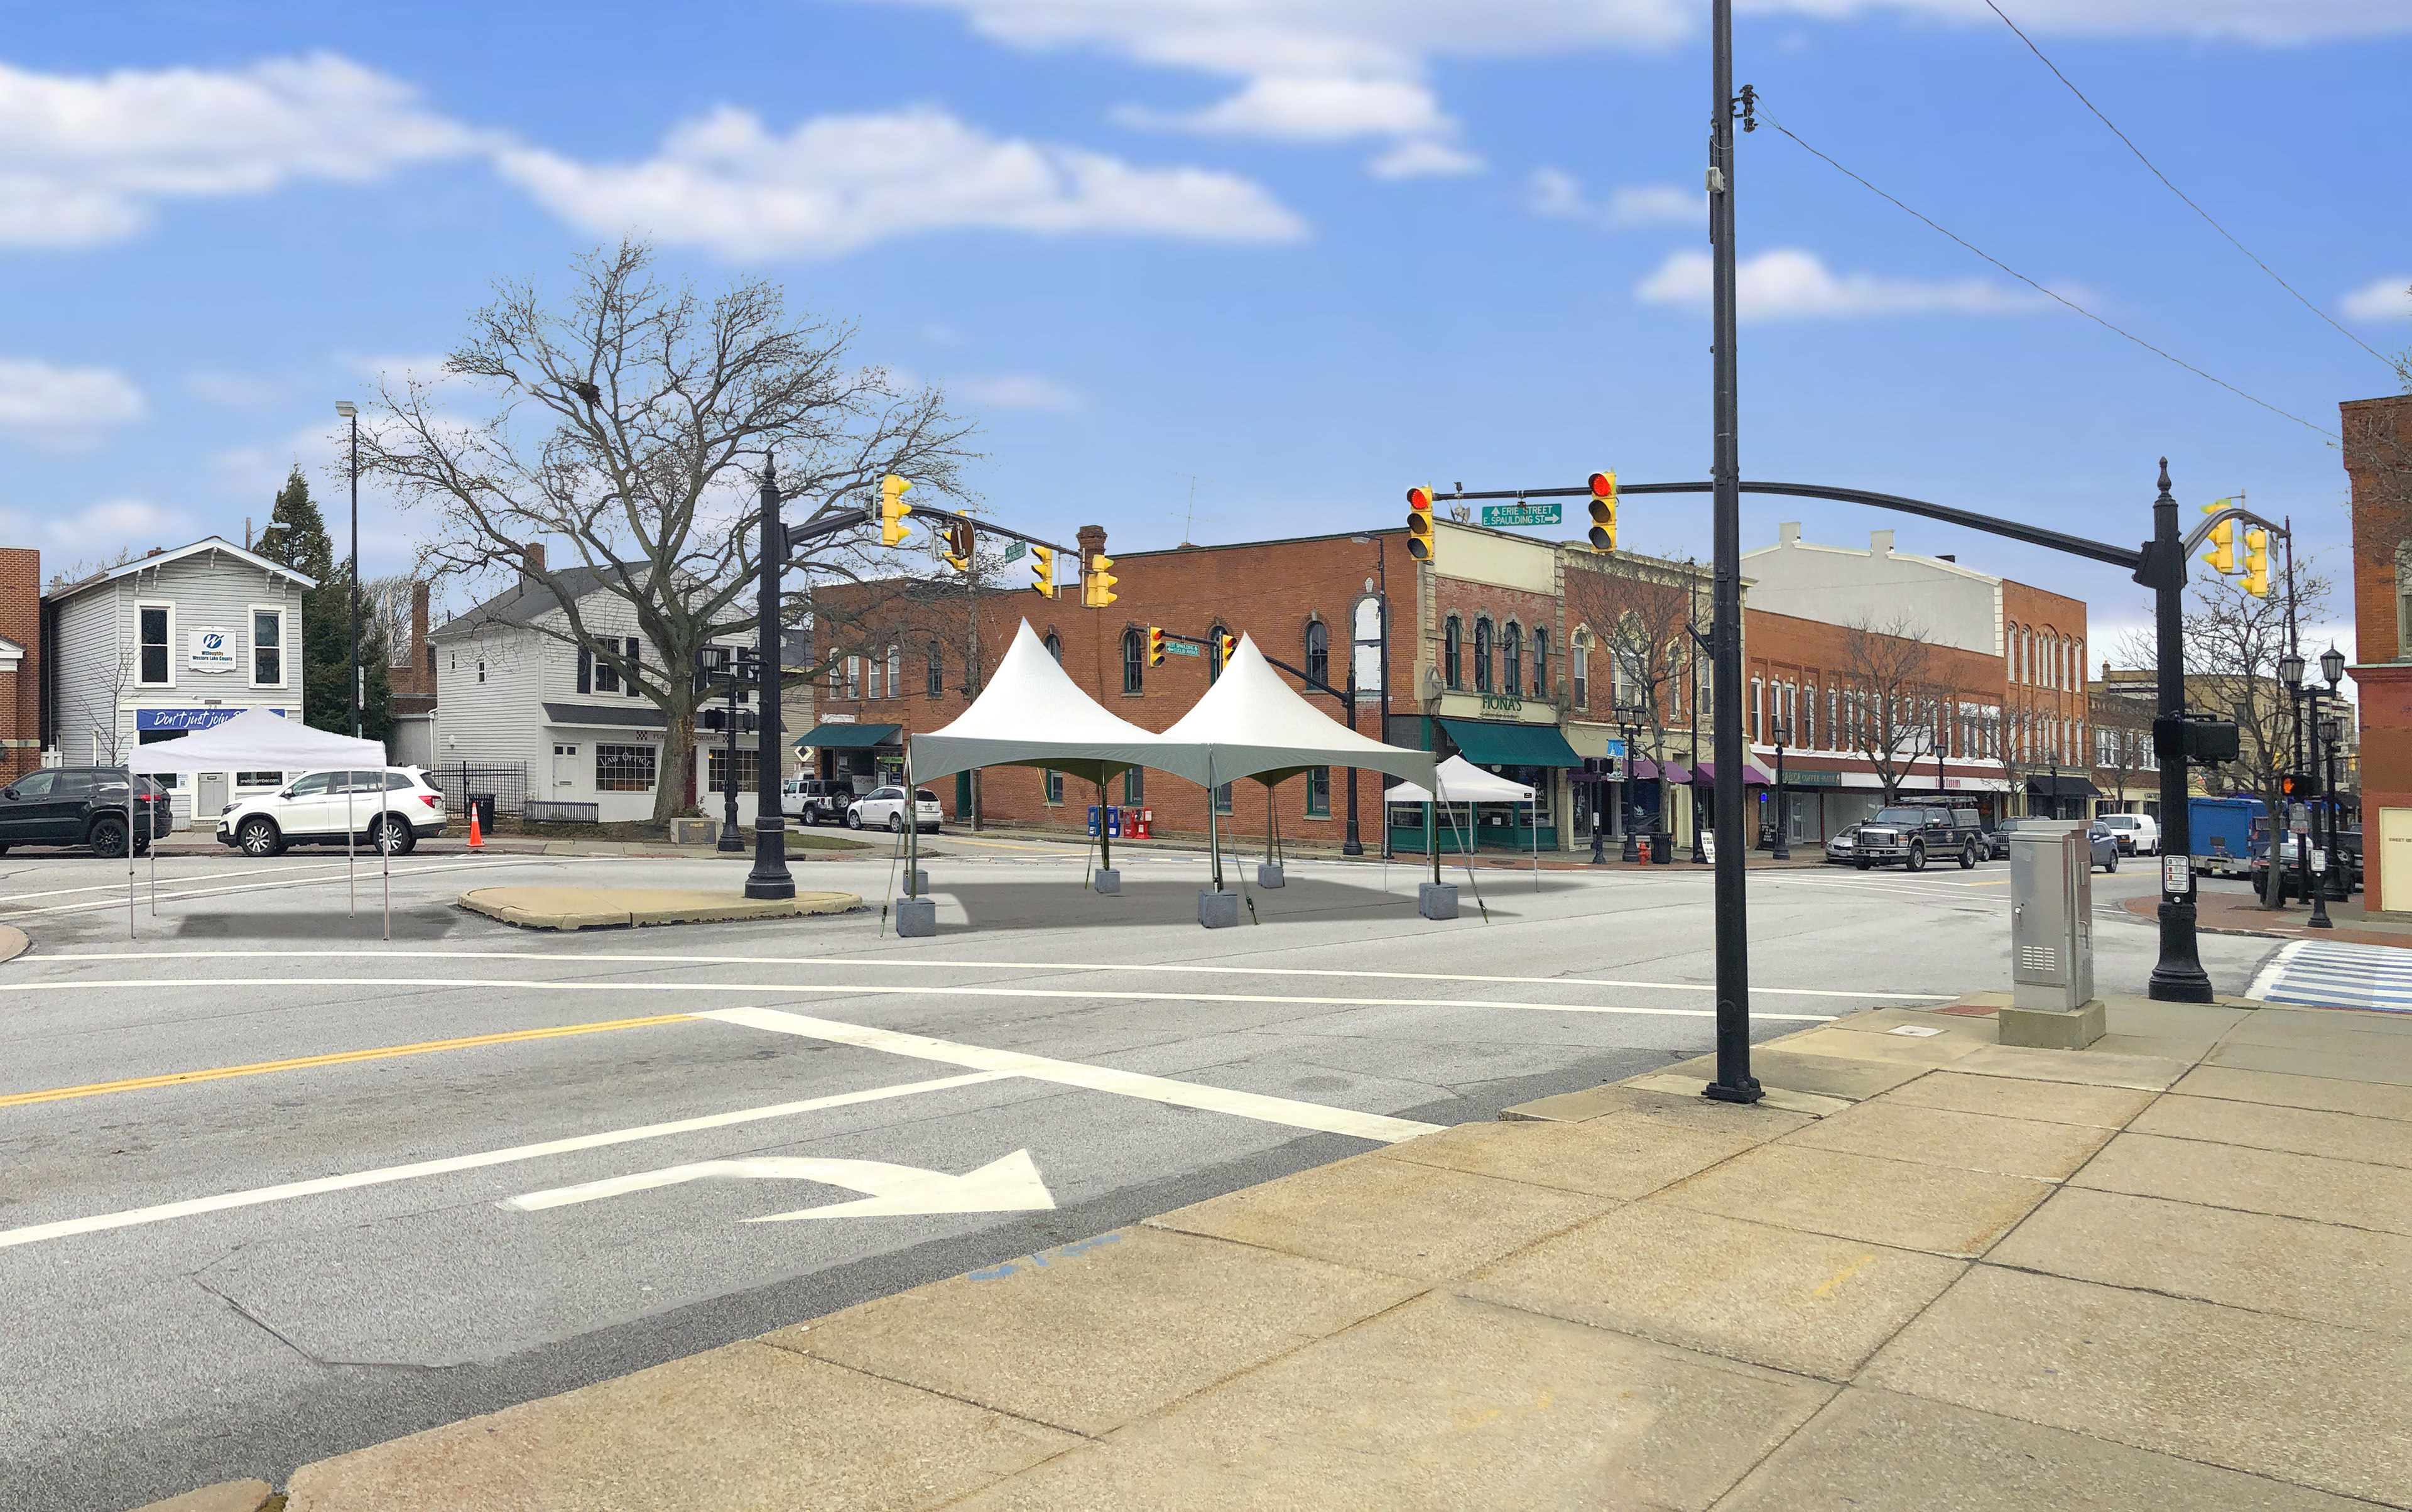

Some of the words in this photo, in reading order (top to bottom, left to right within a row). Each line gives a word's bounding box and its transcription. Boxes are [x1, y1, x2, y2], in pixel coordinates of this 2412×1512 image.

[1502, 507, 1519, 515] ERIE
[1523, 506, 1553, 514] STREET
[1483, 517, 1490, 525] E.
[1491, 516, 1533, 525] SPAULDING
[1535, 515, 1545, 523] ST.
[1482, 694, 1522, 711] FIONA'S
[153, 710, 187, 726] Don't
[183, 710, 210, 728] just
[599, 754, 619, 766] LAW
[622, 752, 653, 768] OFFICE
